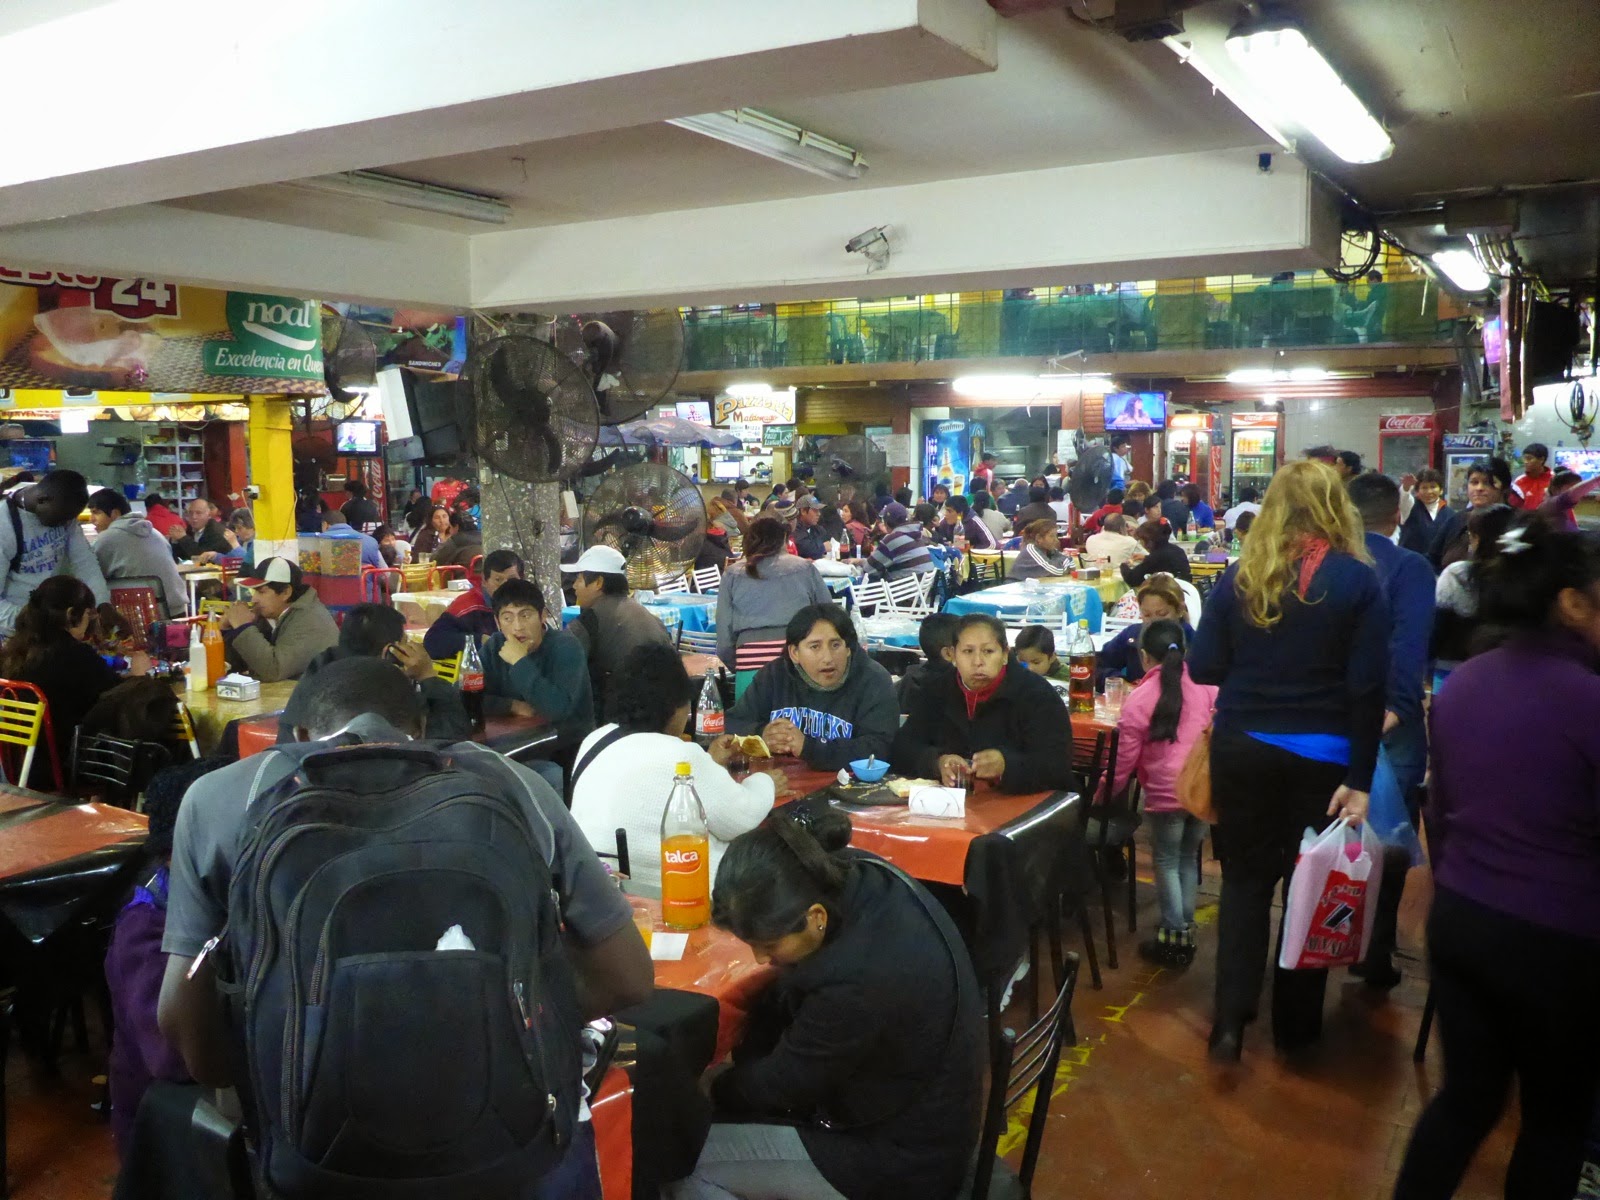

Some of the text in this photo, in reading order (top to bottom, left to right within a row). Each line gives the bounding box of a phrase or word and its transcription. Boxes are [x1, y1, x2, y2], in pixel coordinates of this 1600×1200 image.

[111, 278, 171, 308] 24
[247, 299, 311, 328] noal
[215, 347, 285, 371] Excelencia
[287, 357, 301, 372] en
[716, 395, 794, 424] Pizzeria
[665, 850, 698, 863] talca
